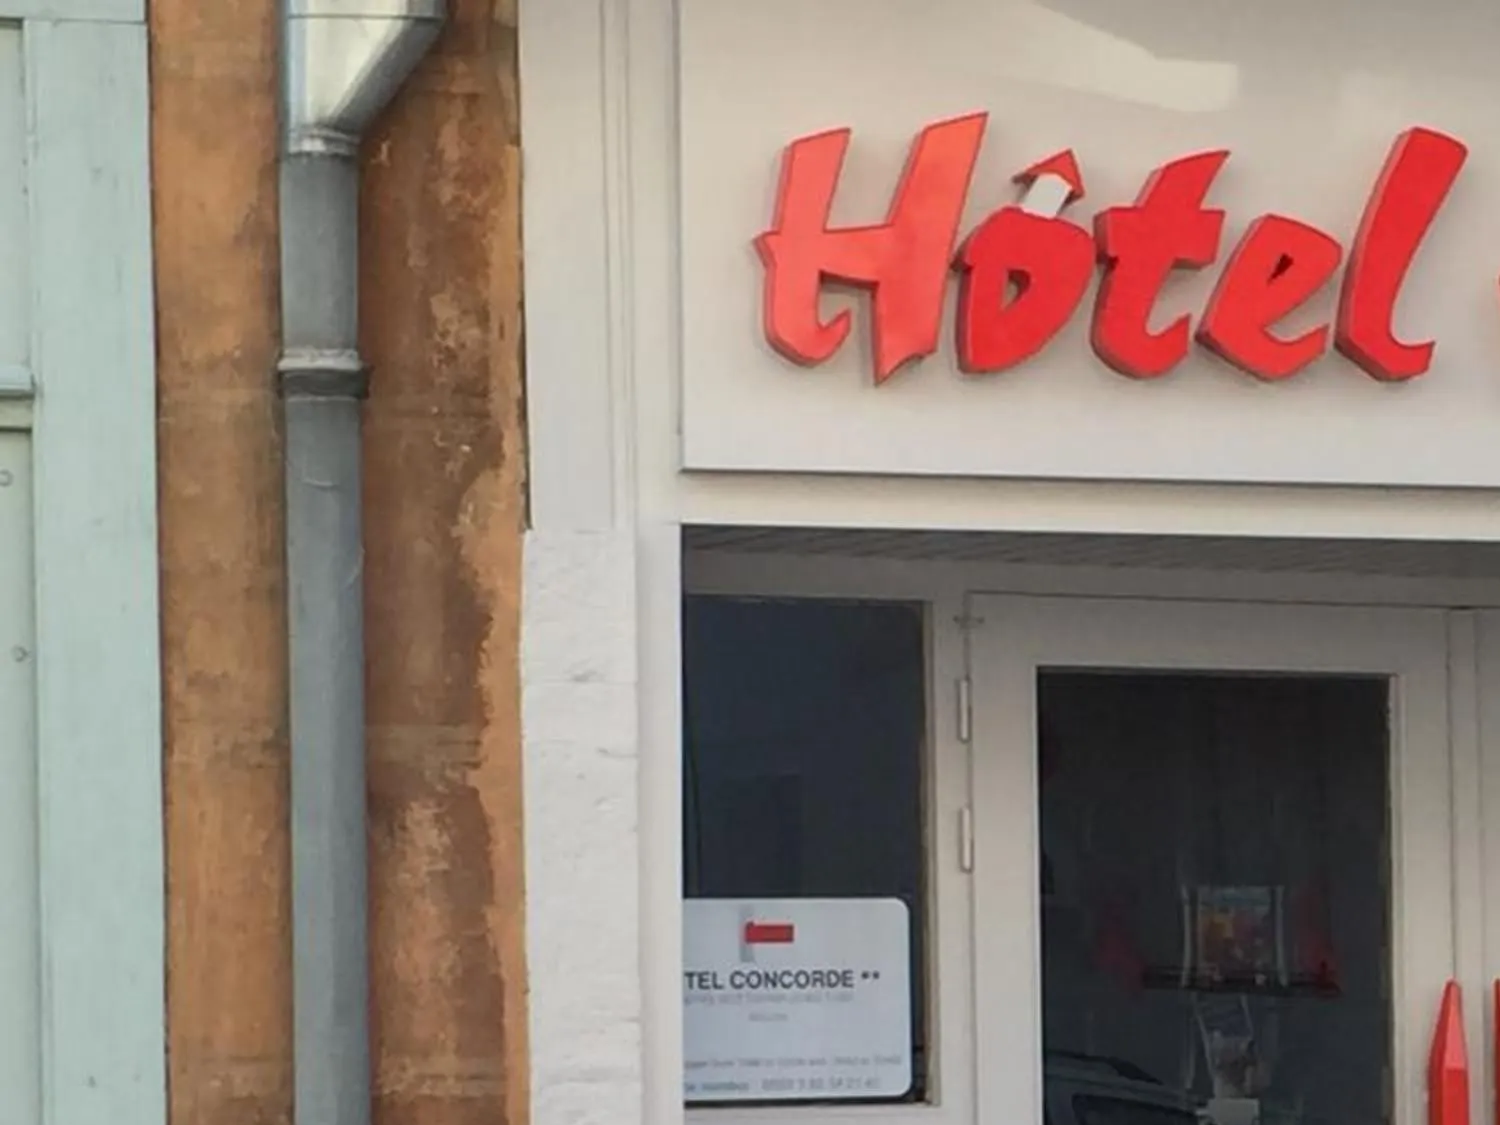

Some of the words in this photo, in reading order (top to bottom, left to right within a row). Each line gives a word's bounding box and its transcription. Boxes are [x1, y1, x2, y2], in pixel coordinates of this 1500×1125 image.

[754, 112, 1468, 387] Hôtel
[685, 971, 724, 990] TEL
[729, 969, 855, 990] CONCORDE
